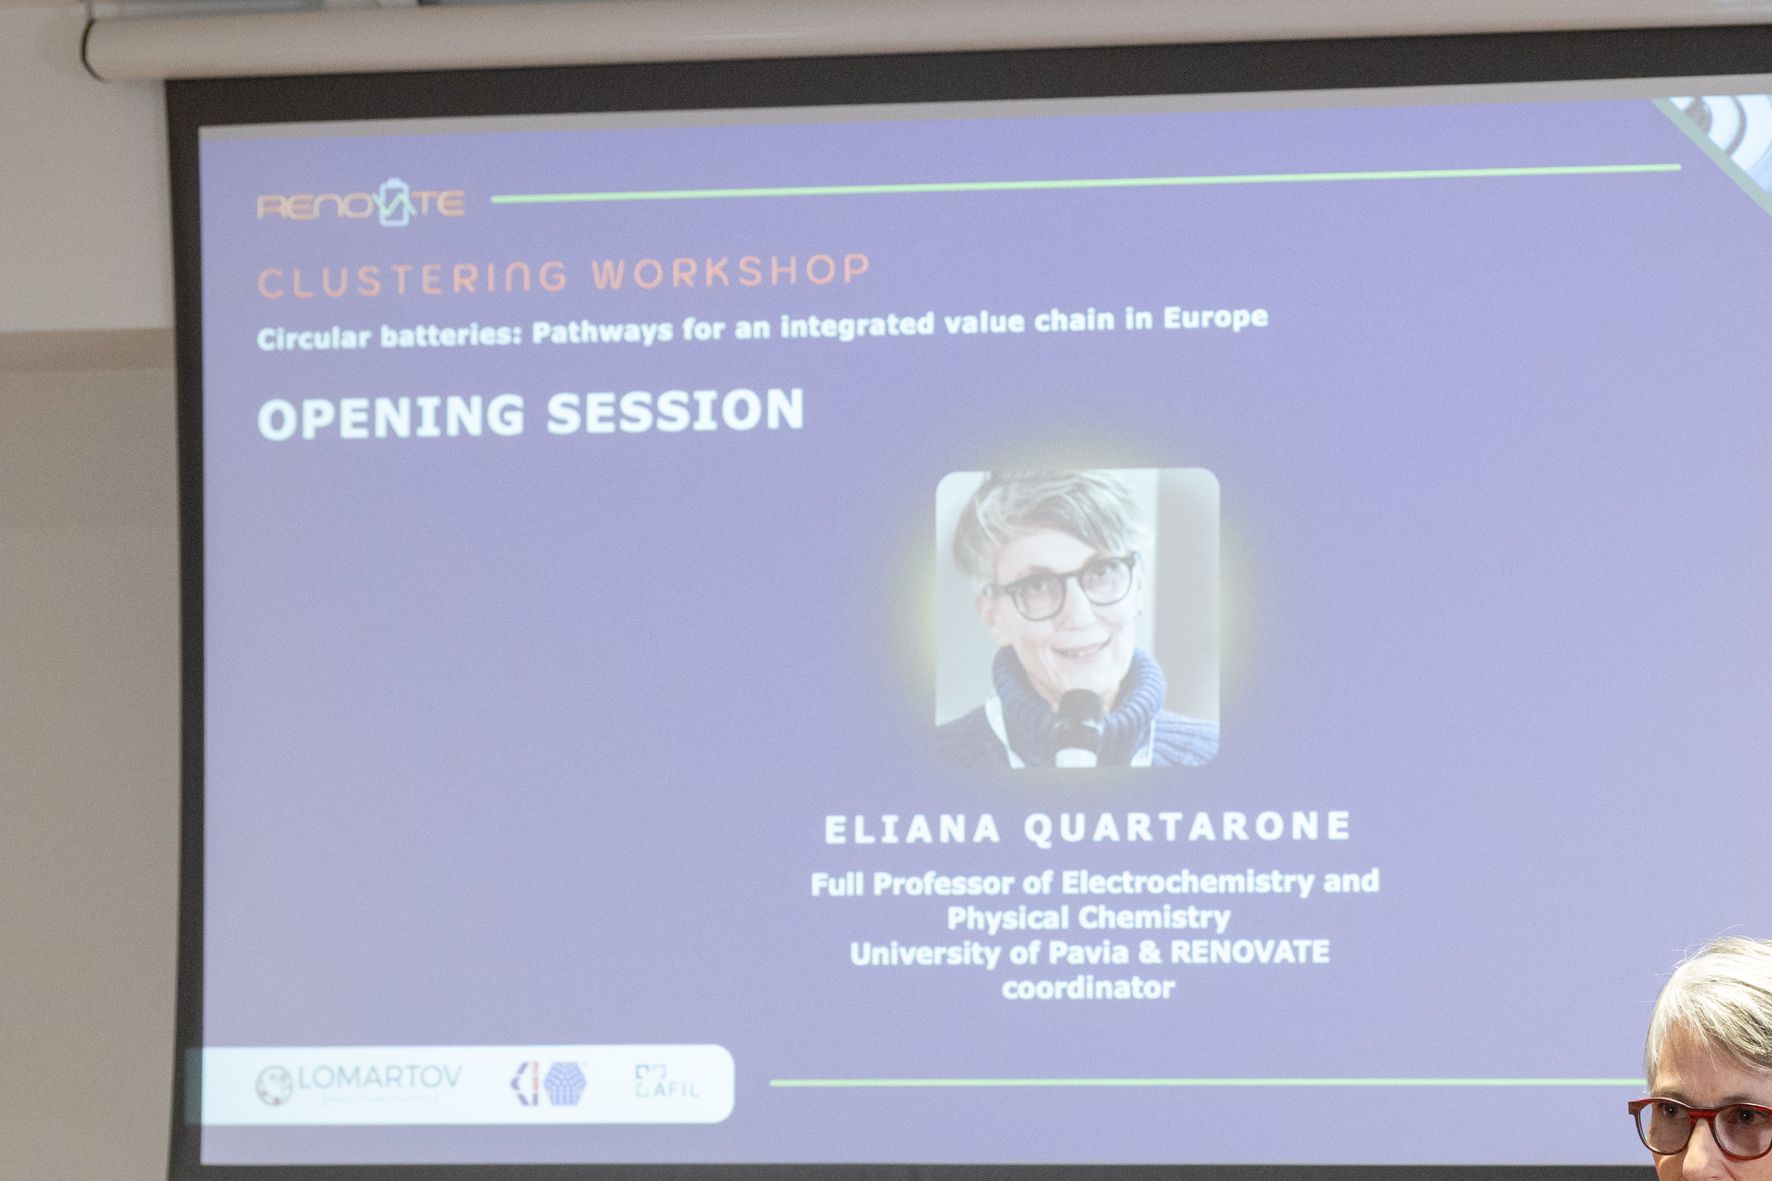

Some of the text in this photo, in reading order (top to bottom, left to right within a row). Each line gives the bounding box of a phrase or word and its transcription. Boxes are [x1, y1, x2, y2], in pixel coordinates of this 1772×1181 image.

[258, 253, 868, 300] CLUSTERING WORKSHOP
[258, 305, 1268, 350] Circular batteries: Pathways for an integrated value chain in Europe
[259, 388, 802, 441] OPENING SESSION
[826, 811, 1349, 849] ELIANA QUARTARONE
[812, 868, 1379, 899] Full Professor of Electrochemistry and
[948, 904, 1231, 935] Physical Chemistry
[851, 939, 1329, 970] University of Pavia & RENOVATE
[1002, 974, 1176, 1000] coordinator
[298, 1065, 463, 1090] LOMARTOV
